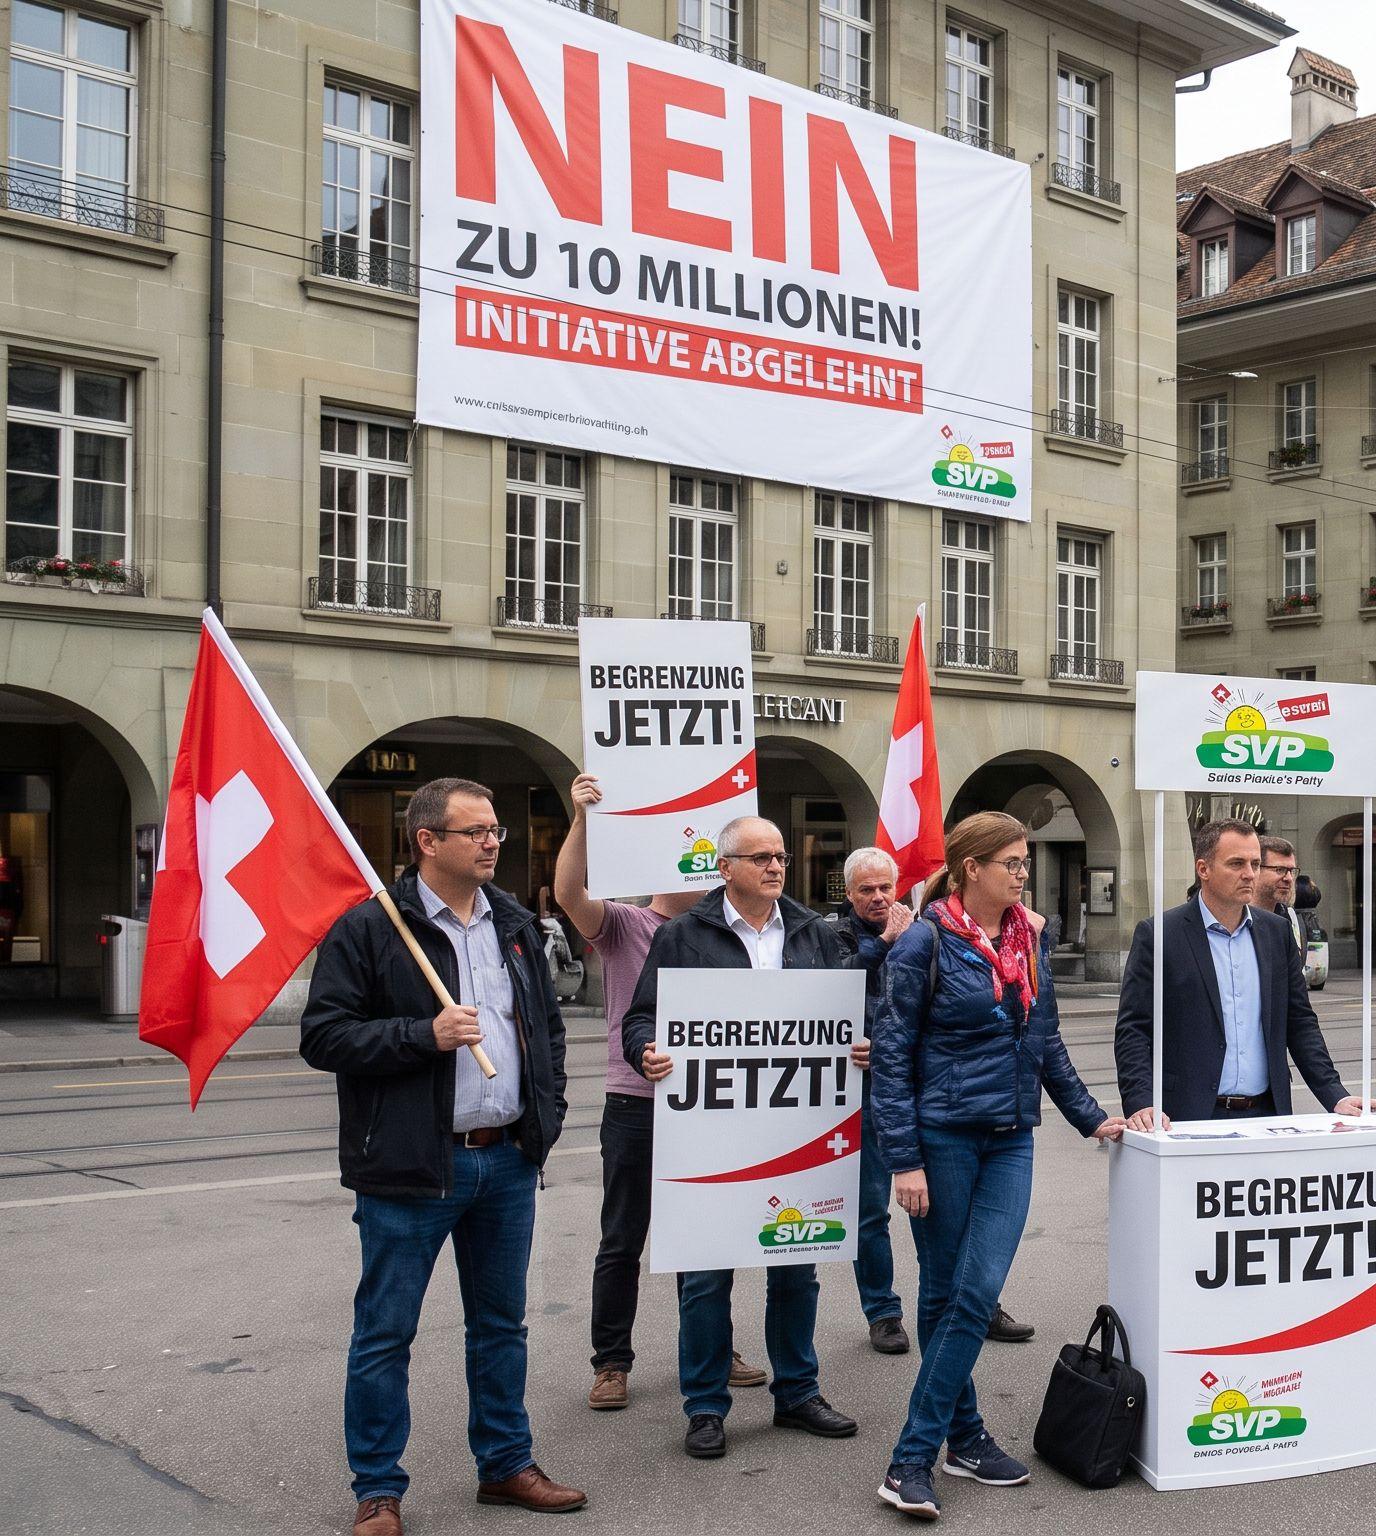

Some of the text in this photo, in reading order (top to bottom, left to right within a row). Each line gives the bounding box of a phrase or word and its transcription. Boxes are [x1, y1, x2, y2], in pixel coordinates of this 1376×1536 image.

[455, 15, 919, 292] NEIN
[456, 219, 922, 351] ZU 10 MILLIONEN!
[465, 300, 917, 405] INITIATIVE ABGELEHNT
[946, 462, 998, 490] SVP
[590, 665, 744, 689] BEGRENZUNG
[594, 700, 742, 748] JETZT!
[1221, 734, 1306, 767] SVP
[690, 853, 718, 871] SV
[667, 1019, 853, 1047] BEGRENZUNG
[666, 1057, 847, 1111] JETZT!
[773, 1222, 827, 1242] SVP
[1208, 1409, 1281, 1441] SVP
